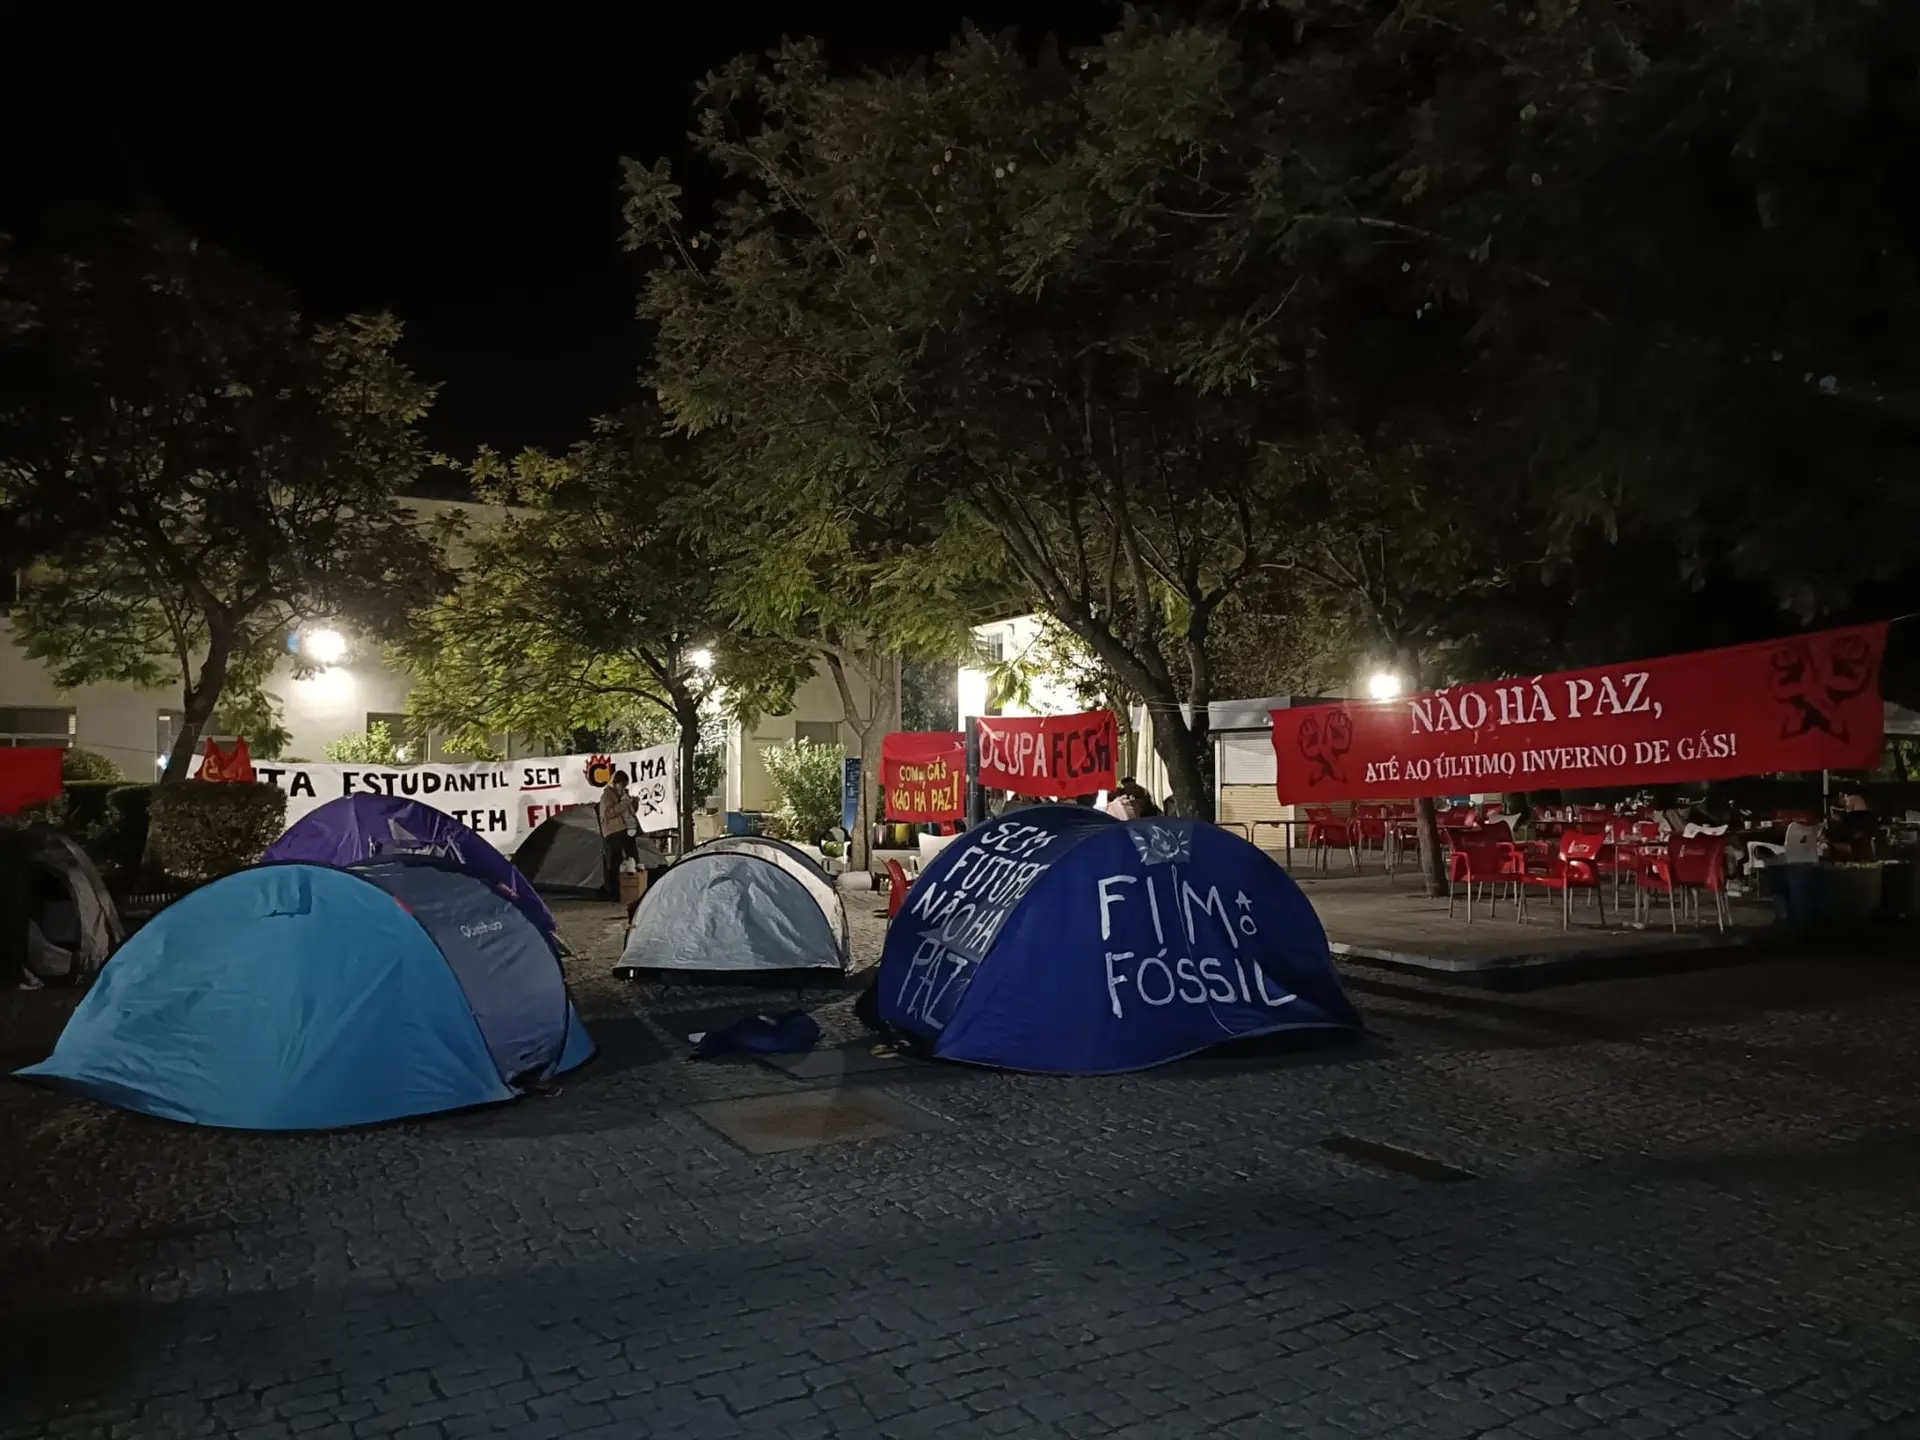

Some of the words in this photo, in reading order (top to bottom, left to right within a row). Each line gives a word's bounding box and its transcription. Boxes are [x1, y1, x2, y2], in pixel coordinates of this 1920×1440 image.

[1408, 688, 1487, 734] NÃO
[1496, 675, 1556, 725] HÁ
[1565, 672, 1663, 719] PAZ,
[899, 765, 919, 781] COM
[927, 756, 947, 780] GÁS
[1051, 722, 1111, 778] FCSH
[1365, 755, 1400, 783] ATÉ
[1404, 759, 1431, 781] AO
[1433, 752, 1516, 779] ÚLTIMO
[1521, 745, 1627, 772] INVERNO
[1634, 740, 1670, 764] DE
[1677, 729, 1737, 761] GÁS!
[251, 767, 317, 797] TA
[343, 771, 509, 796] ESTUDANTIL
[523, 767, 560, 786] SEM
[914, 781, 927, 812] HÁ
[451, 808, 507, 832] TEM
[981, 822, 1058, 858] SEM
[911, 882, 977, 942] NÃO
[1098, 875, 1239, 948] FIM
[896, 937, 968, 1030] PAZ
[1104, 948, 1298, 1019] FÓSSIL
